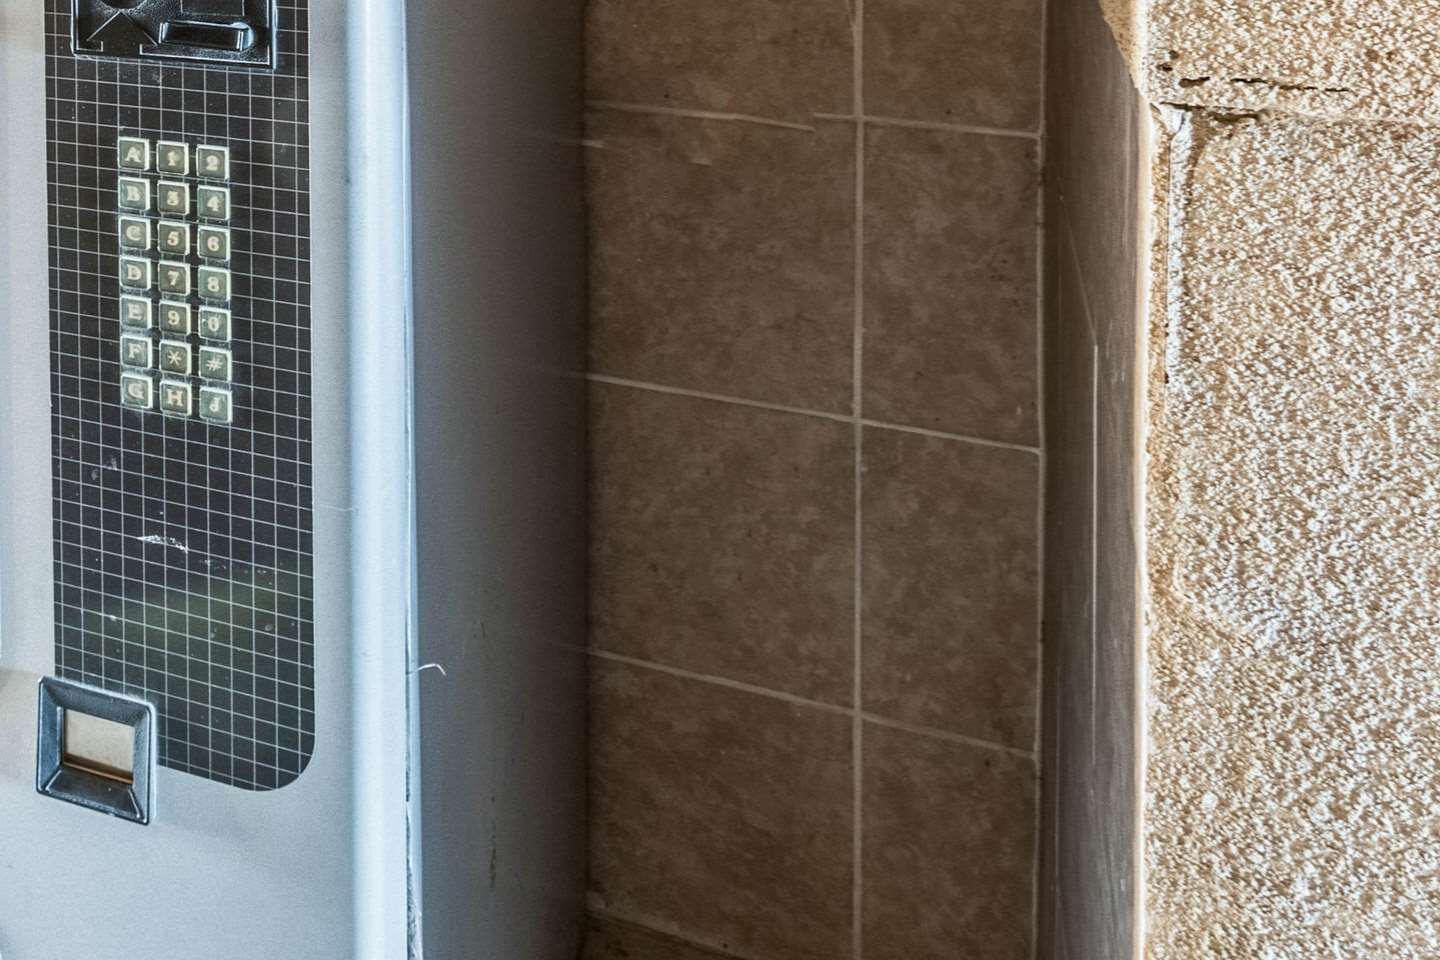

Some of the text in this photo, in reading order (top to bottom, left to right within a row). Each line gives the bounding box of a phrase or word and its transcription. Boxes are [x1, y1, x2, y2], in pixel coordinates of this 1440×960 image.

[125, 146, 219, 171] A 1 2
[207, 196, 220, 212] 4
[126, 225, 220, 251] C 5 6
[127, 264, 219, 292] D 7 8
[128, 303, 142, 320] E
[167, 310, 180, 326] 9
[128, 343, 142, 359] F
[127, 382, 145, 400] G
[167, 389, 184, 406] H
